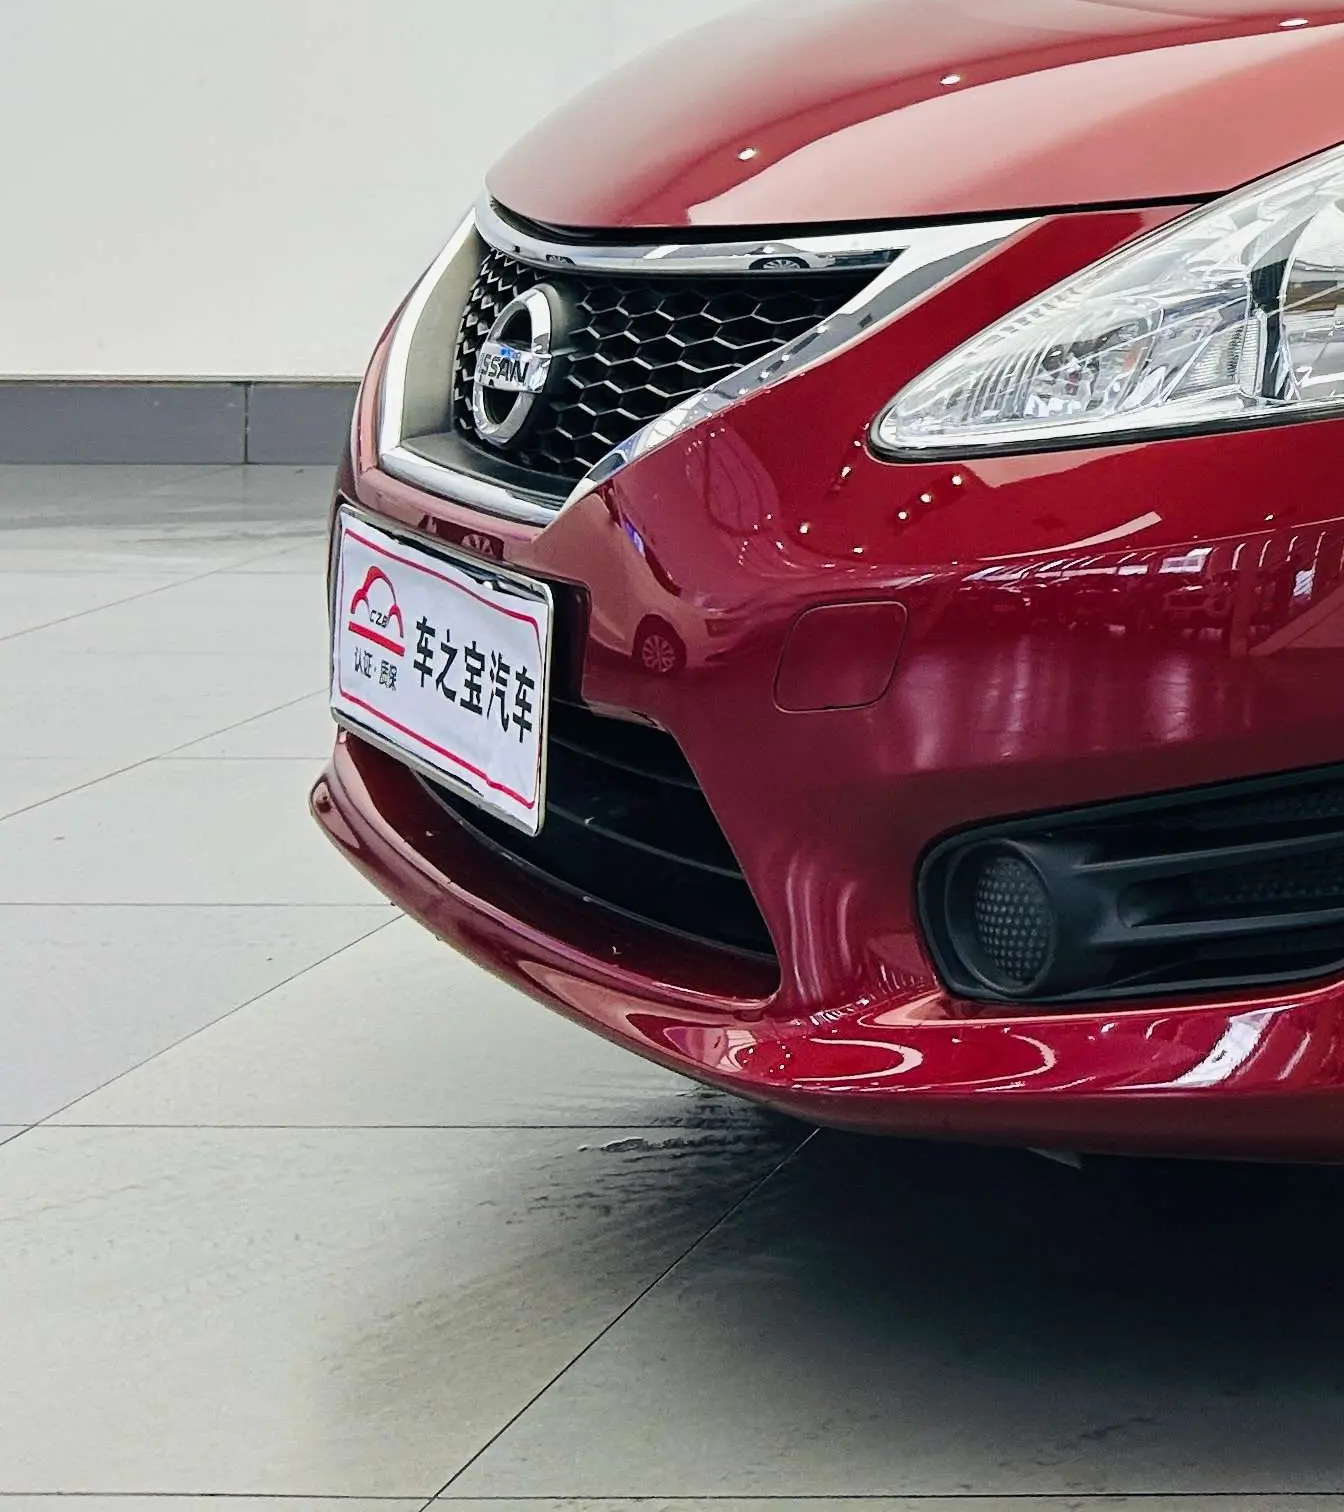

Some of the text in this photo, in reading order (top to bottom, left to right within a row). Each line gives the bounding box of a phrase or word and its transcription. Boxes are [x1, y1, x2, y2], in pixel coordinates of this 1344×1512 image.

[480, 353, 530, 383] SSAN
[369, 609, 389, 629] CZB
[413, 615, 536, 744] 车之宝汽车
